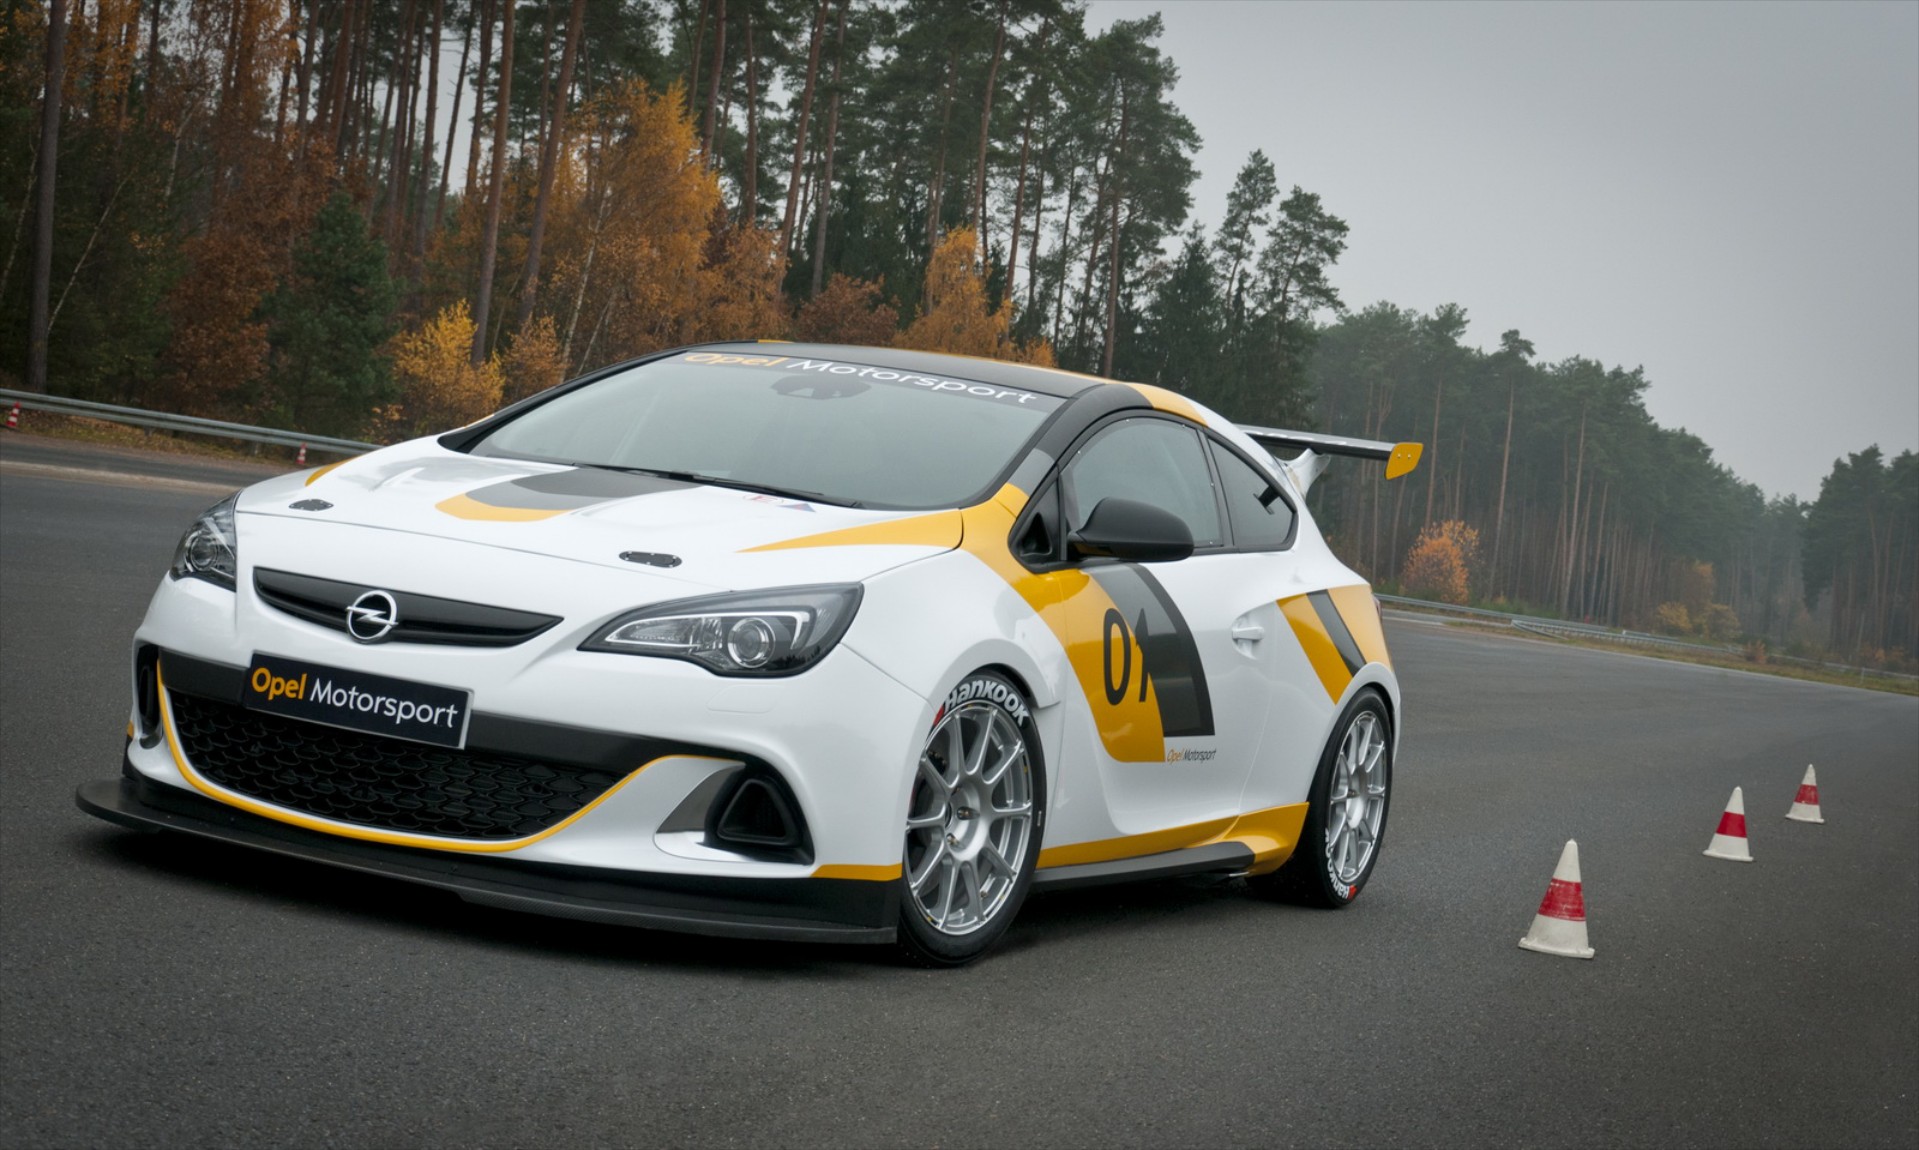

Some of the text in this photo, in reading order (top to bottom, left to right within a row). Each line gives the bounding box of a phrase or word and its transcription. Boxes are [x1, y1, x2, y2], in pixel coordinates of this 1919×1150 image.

[685, 353, 1037, 404] Opel Motorsport
[1103, 607, 1150, 706] 01
[251, 667, 459, 729] Opel Motorsport
[1167, 747, 1217, 765] Opel Motorsport
